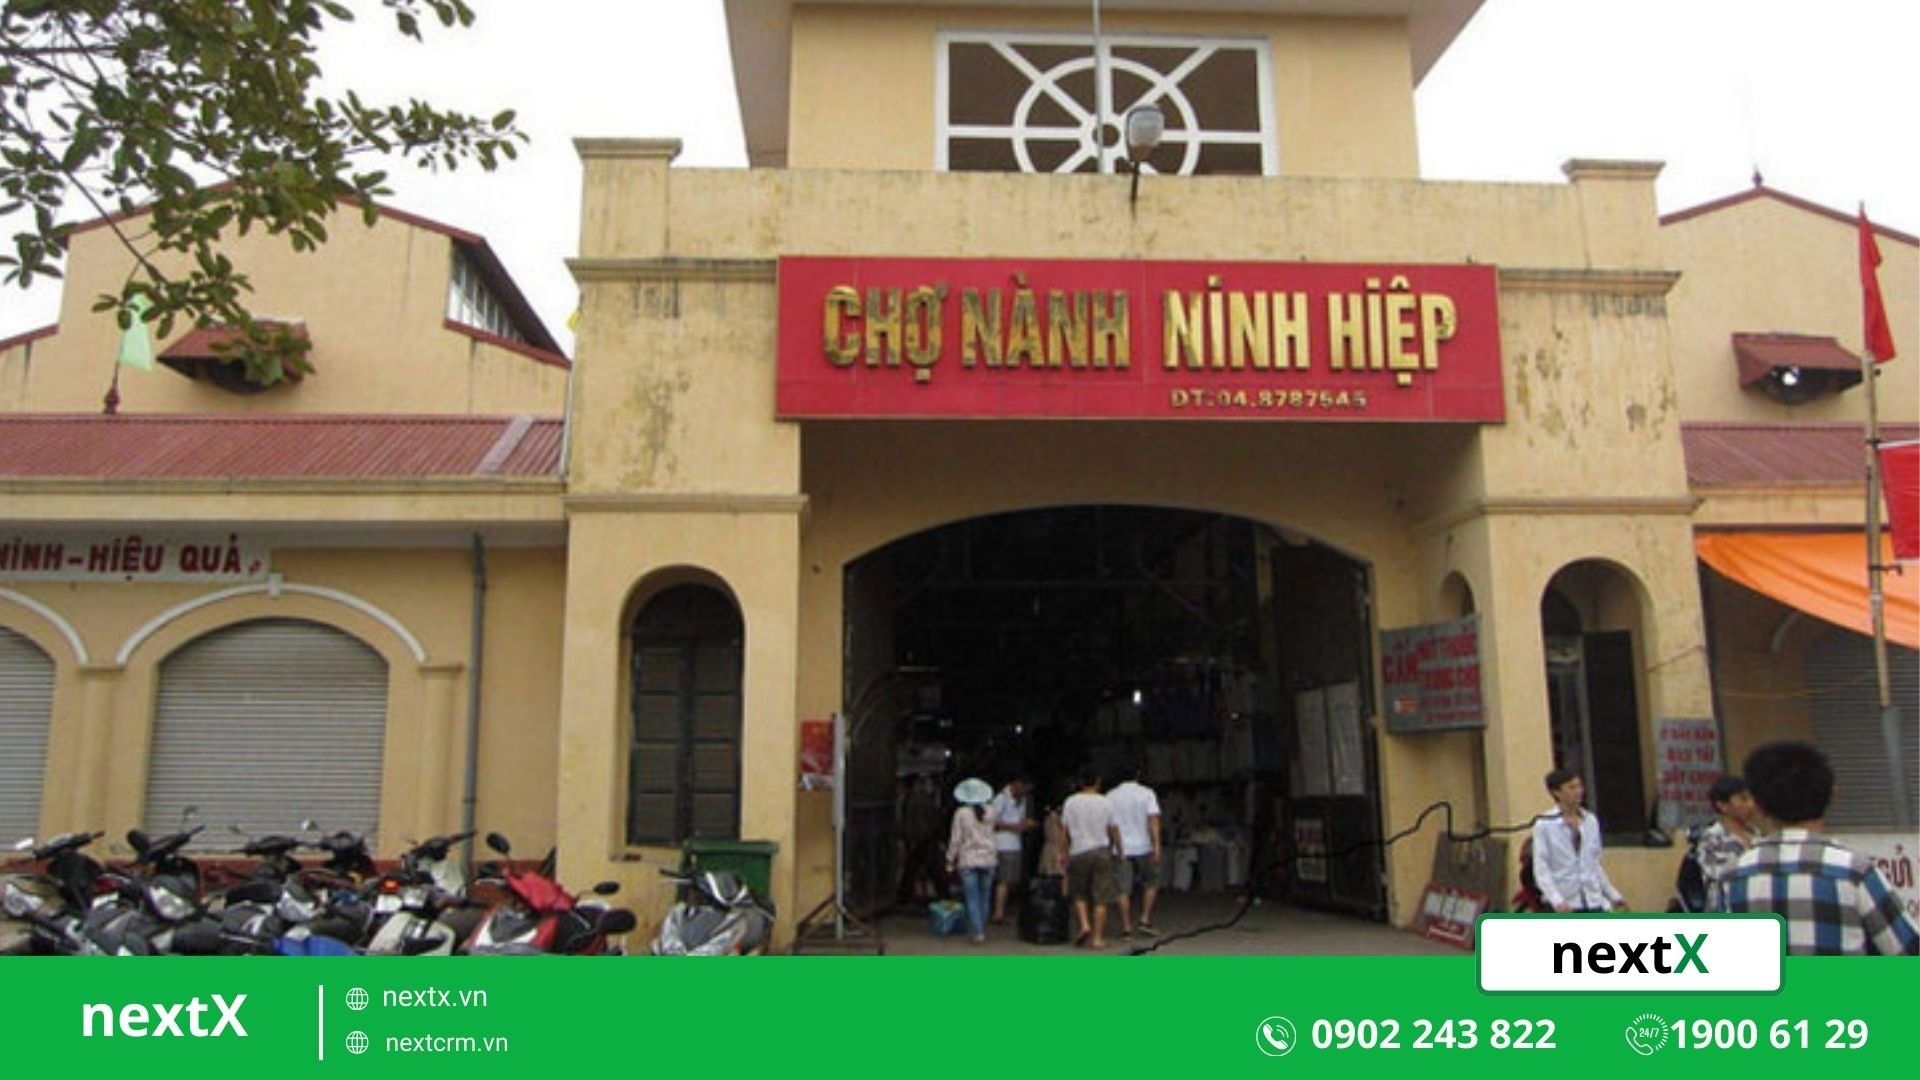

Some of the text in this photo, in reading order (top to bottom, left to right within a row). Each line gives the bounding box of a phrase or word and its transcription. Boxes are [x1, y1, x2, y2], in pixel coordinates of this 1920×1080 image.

[822, 271, 1457, 386] CHỢ NÀNH NINH HIỆP
